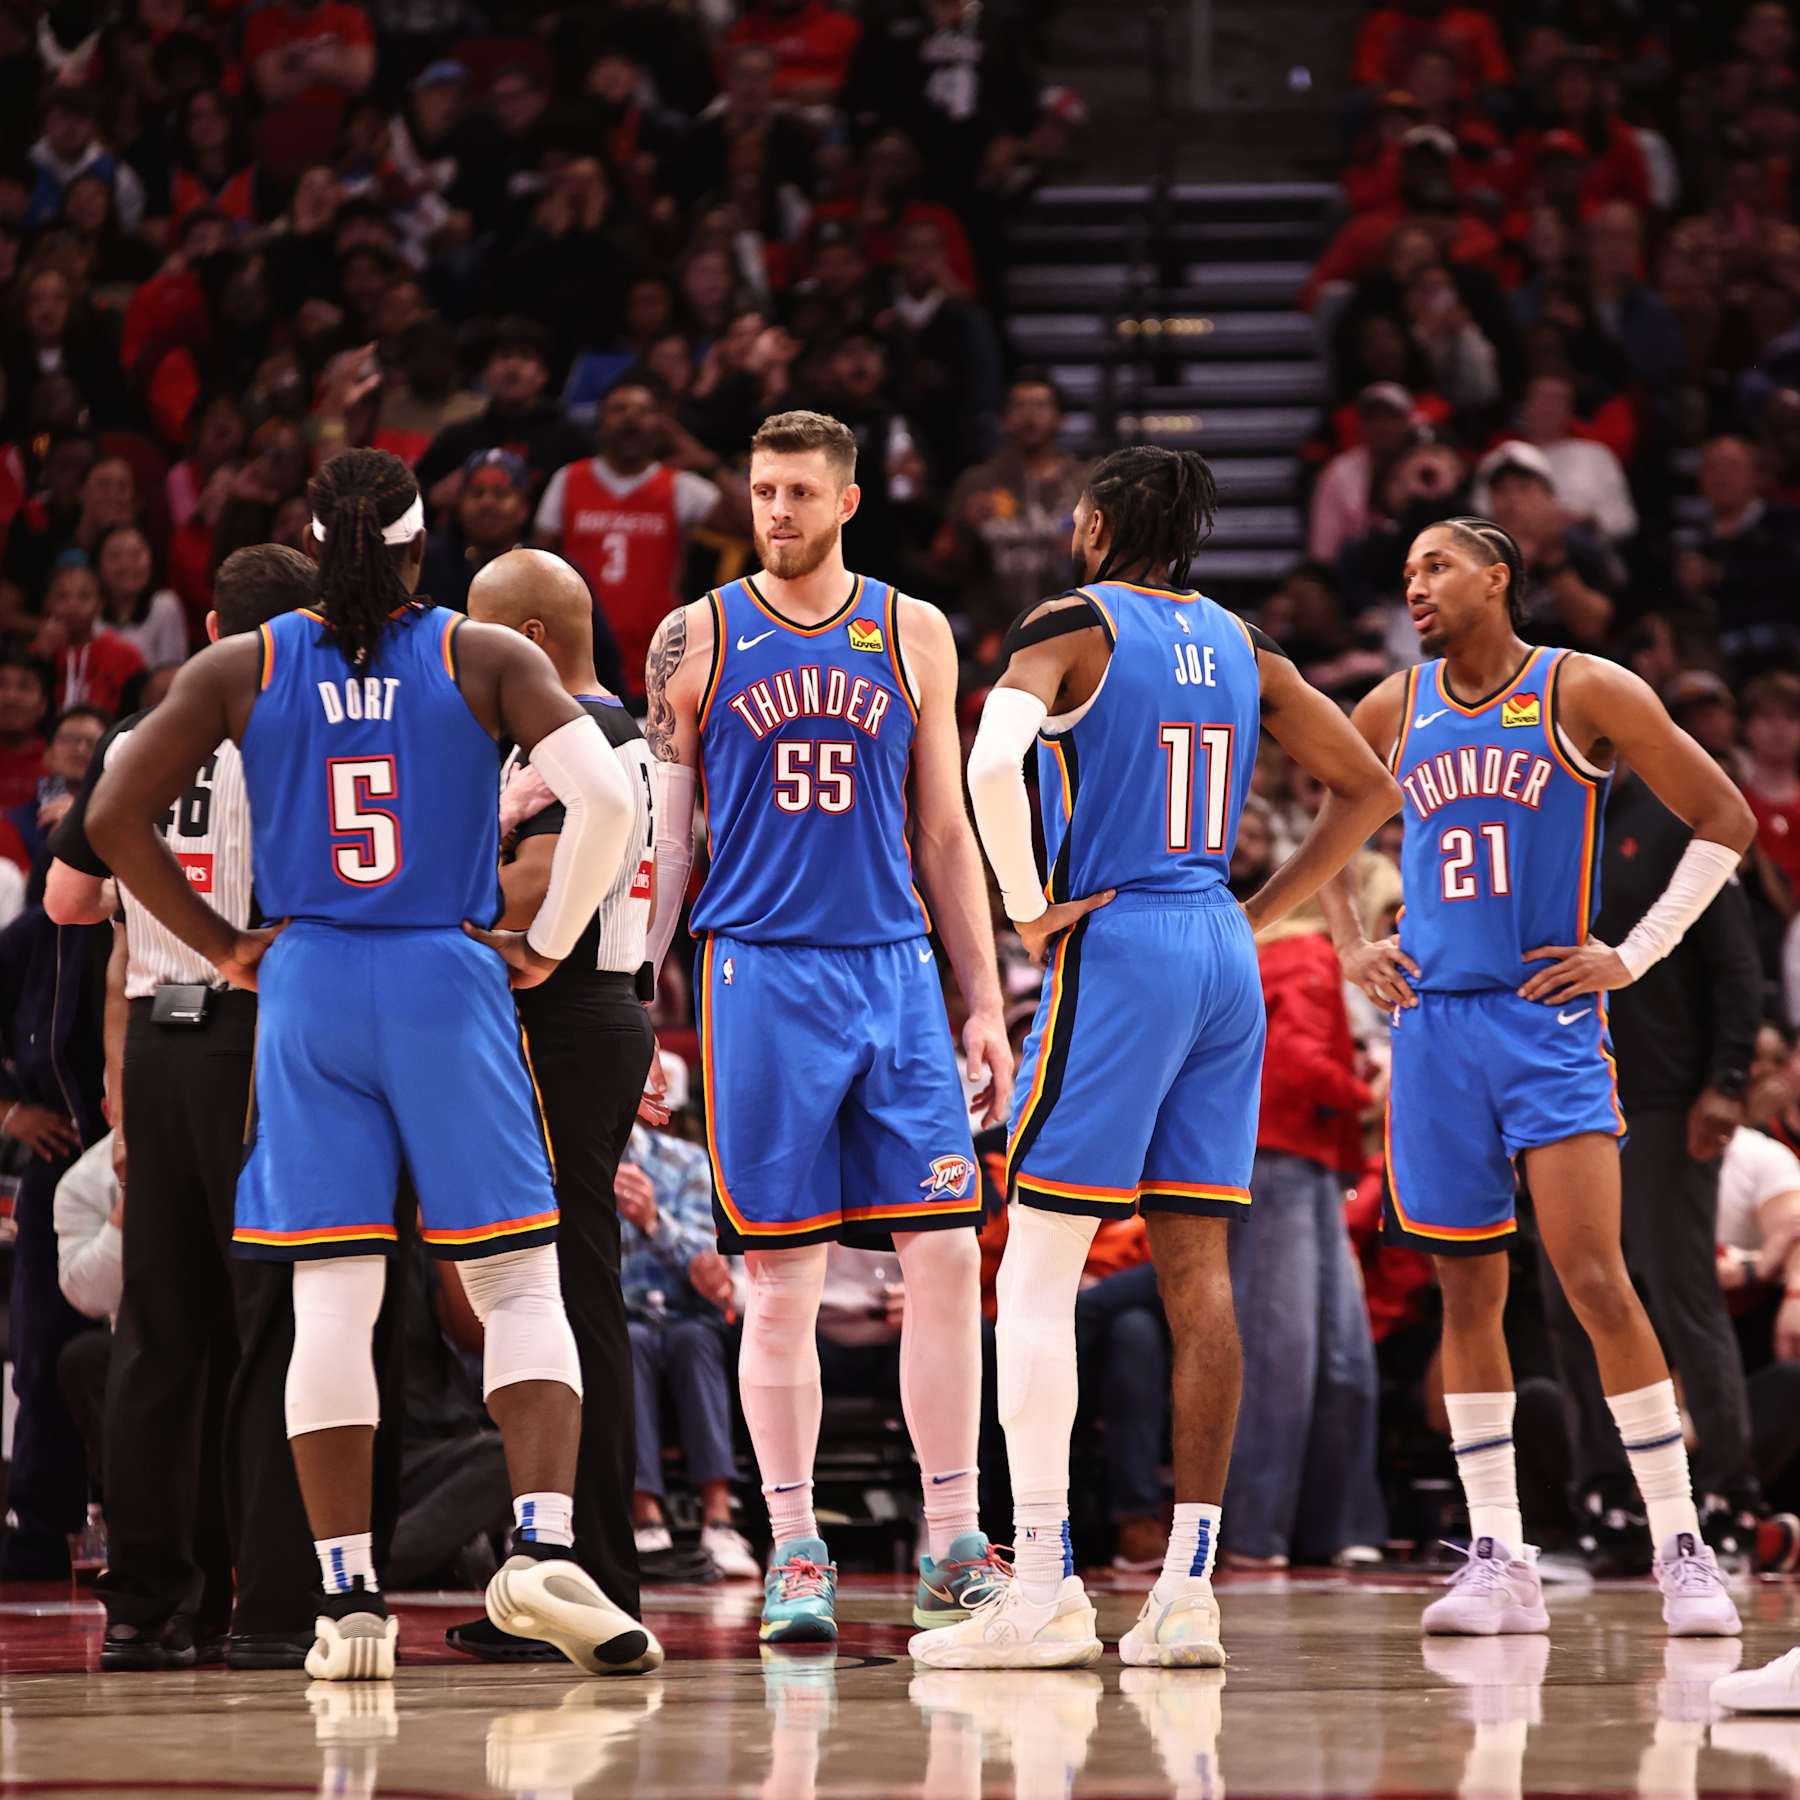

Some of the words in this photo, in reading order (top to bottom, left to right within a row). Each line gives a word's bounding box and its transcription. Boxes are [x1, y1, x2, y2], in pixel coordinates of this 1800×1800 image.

[601, 532, 628, 582] 3
[317, 677, 399, 724] DORT
[728, 665, 890, 740] THUNDER
[1173, 643, 1216, 687] JOE
[774, 739, 856, 815] 55
[1159, 721, 1235, 854] 11
[1402, 744, 1553, 820] THUNDER
[326, 754, 402, 888] 5
[1439, 821, 1510, 901] 21
